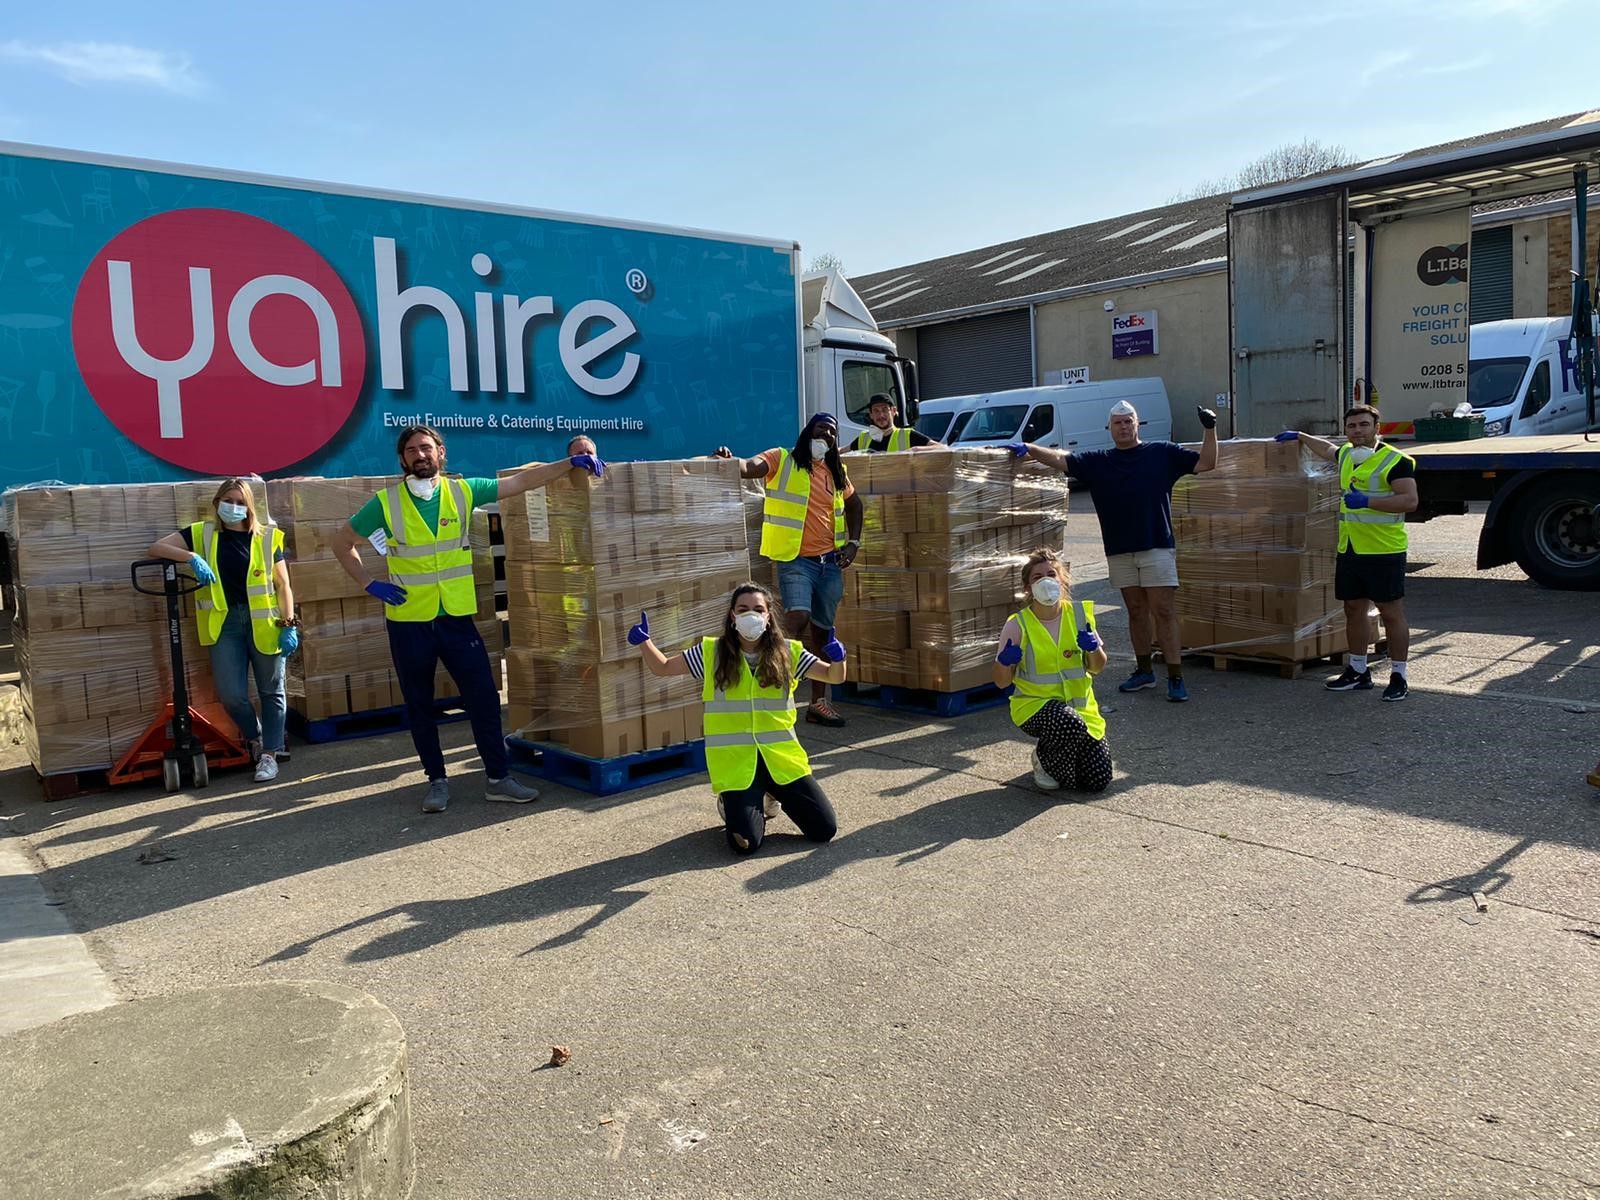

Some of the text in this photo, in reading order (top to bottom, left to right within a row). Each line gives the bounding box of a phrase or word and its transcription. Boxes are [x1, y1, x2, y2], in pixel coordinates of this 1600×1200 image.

[1412, 304, 1449, 317] YOUR
[1113, 314, 1145, 329] FedEx
[1403, 318, 1459, 332] FREIGHT
[1430, 333, 1467, 345] SOLU
[1064, 368, 1086, 379] UNIT
[1421, 363, 1466, 376] 0208 5
[383, 412, 644, 432] Event Furniture & Catering Equipment Hire
